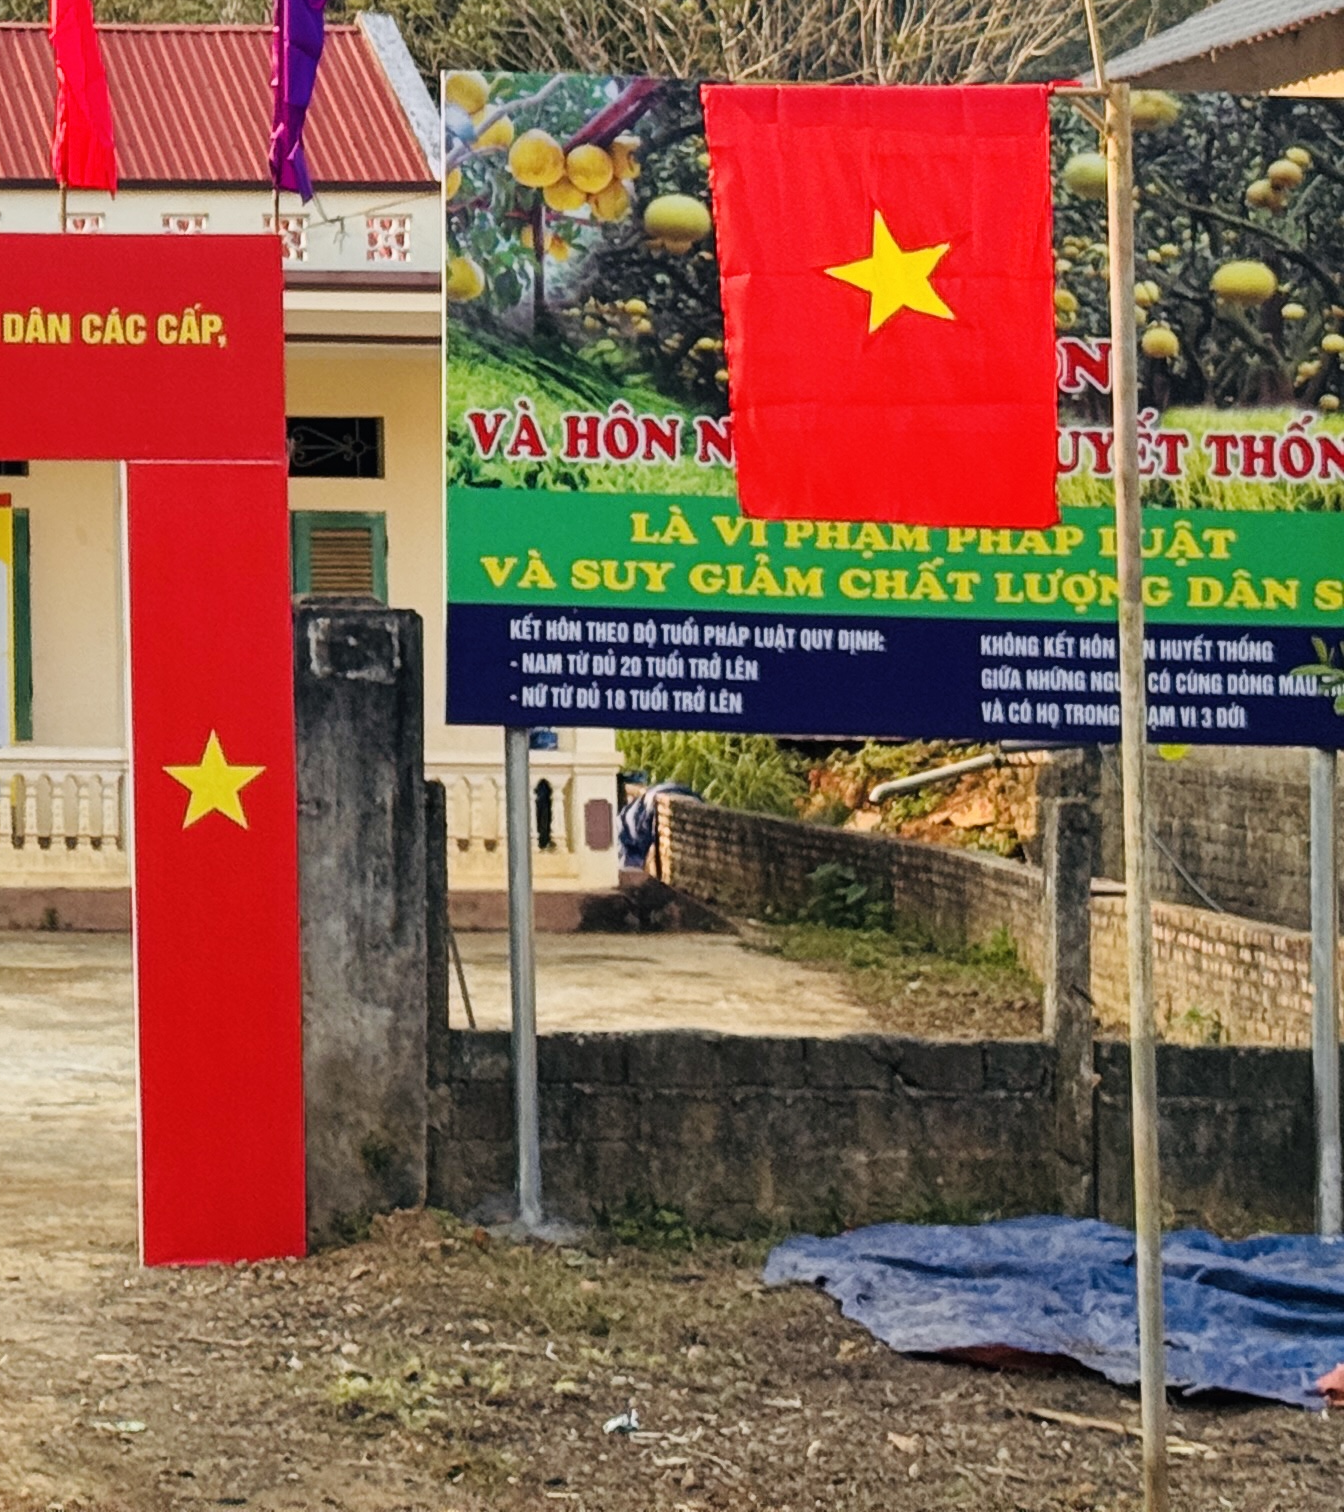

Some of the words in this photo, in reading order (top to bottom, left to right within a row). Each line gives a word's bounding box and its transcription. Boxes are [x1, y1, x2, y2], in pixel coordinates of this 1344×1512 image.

[3, 307, 71, 344] DÂN
[82, 308, 147, 345] CÁC
[157, 303, 227, 349] CẤP,
[468, 399, 547, 457] VÀ
[564, 402, 679, 461] HÔN
[1205, 414, 1344, 479] THỐN
[630, 504, 699, 545] LÀ
[713, 516, 770, 546] VI
[784, 520, 929, 559] PHẠM
[480, 548, 557, 589] VÀ
[571, 559, 675, 592] SUY
[688, 553, 824, 598] GIẢM
[838, 556, 982, 602] CHẤT
[1187, 568, 1300, 609] DÂN
[1314, 580, 1344, 610] S
[510, 612, 542, 640] KẾT
[546, 615, 582, 642] HÔN
[585, 622, 630, 643] THEO
[633, 618, 657, 648] ĐỘ
[661, 616, 699, 645] TUỔI
[704, 621, 751, 647] PHÁP
[754, 623, 796, 654] LUẬT
[800, 628, 834, 651] QUY
[980, 631, 1039, 657] KHÔNG
[1044, 630, 1075, 658] KẾT
[1079, 633, 1116, 659] HÔN
[1160, 633, 1213, 662] HUYẾT
[1217, 633, 1275, 663] THỐNG
[522, 652, 562, 674] NAM
[620, 655, 642, 677] 20
[646, 649, 684, 679] TUỔI
[726, 655, 759, 681] LÊN
[1148, 667, 1170, 694] CÓ
[605, 689, 626, 710] 18
[630, 681, 669, 712] TUỔI
[710, 688, 743, 714] LÊN
[981, 698, 1005, 723] VÀ
[1008, 698, 1032, 724] CÓ
[1036, 702, 1060, 729] HỌ
[1064, 703, 1120, 726] TRONG
[1180, 706, 1197, 728] VI
[1201, 708, 1212, 728] 3
